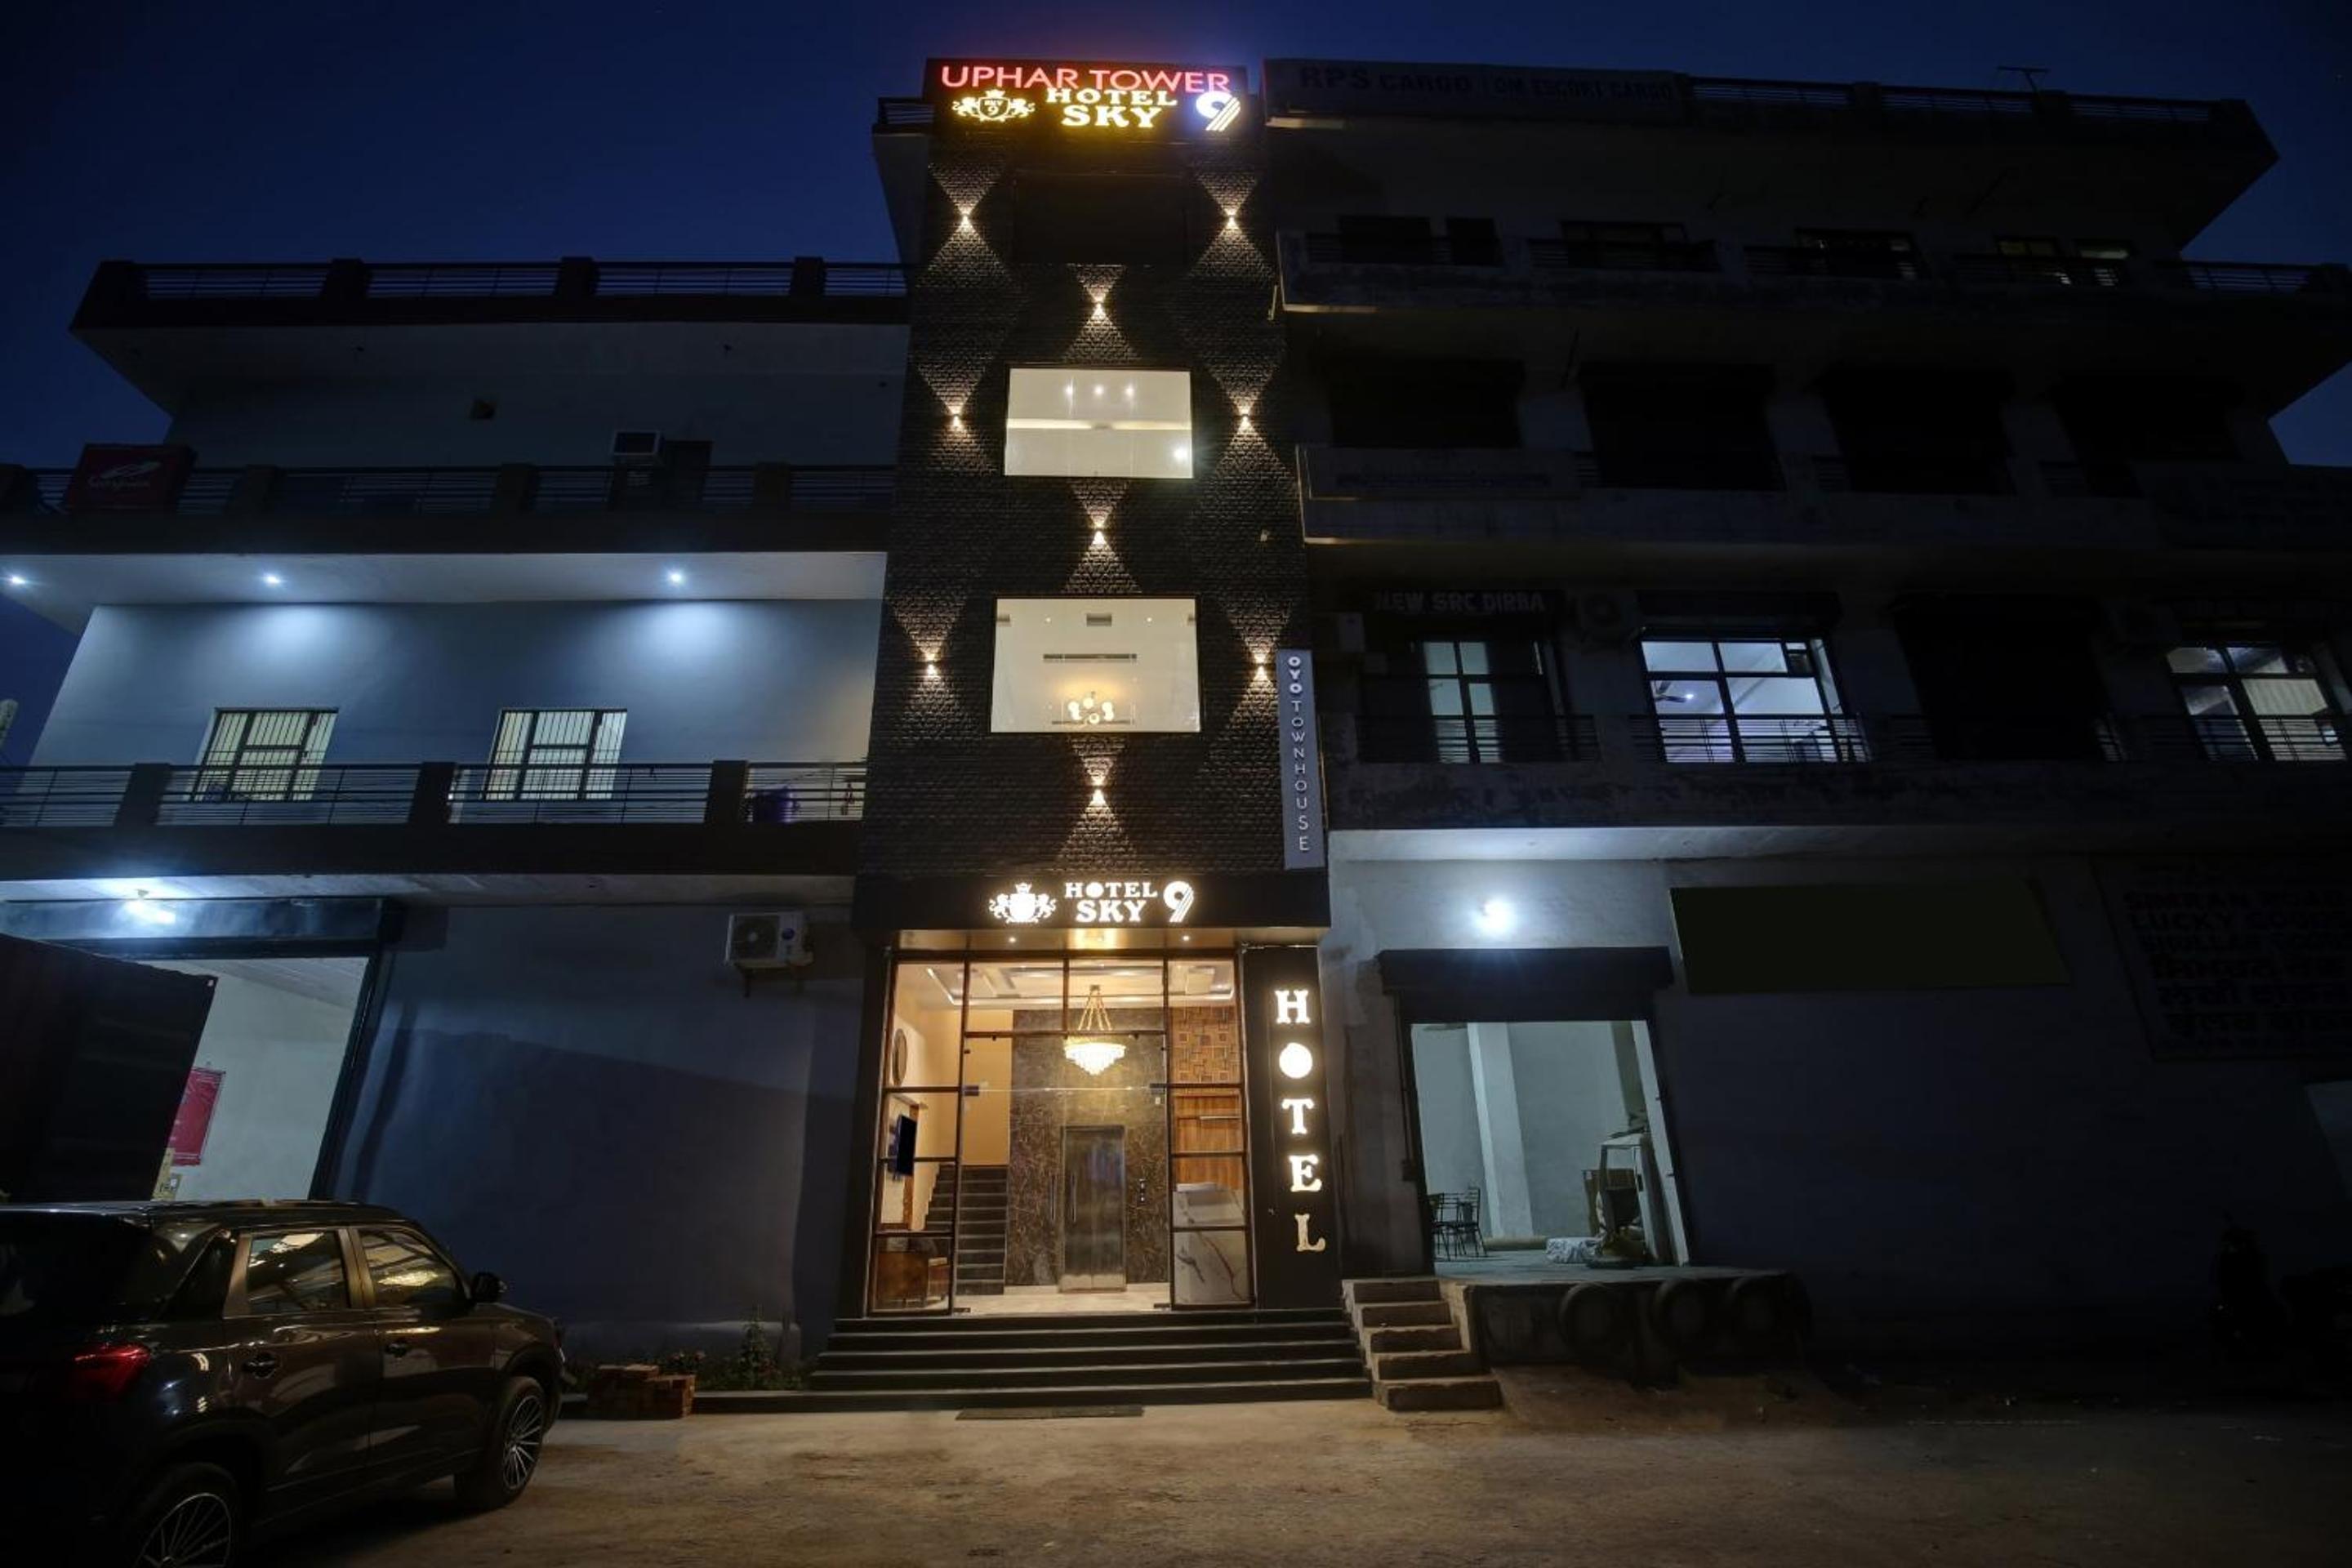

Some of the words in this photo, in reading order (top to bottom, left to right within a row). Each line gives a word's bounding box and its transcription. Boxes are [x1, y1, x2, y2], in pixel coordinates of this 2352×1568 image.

[941, 66, 1079, 90] UPHAR
[1089, 69, 1231, 94] TOWER
[1046, 87, 1178, 107] HOTEL
[1299, 66, 1370, 90] RPS
[1379, 74, 1473, 93] CARGO
[1062, 105, 1163, 128] SKY
[1196, 91, 1242, 131] 9
[1287, 656, 1303, 694] OYO
[1291, 700, 1310, 852] TOWNHOUSE
[1064, 881, 1158, 898] HOTEL
[1076, 899, 1147, 923] SKY
[1163, 880, 1194, 923] 9
[1274, 989, 1326, 1253] HOTEL
